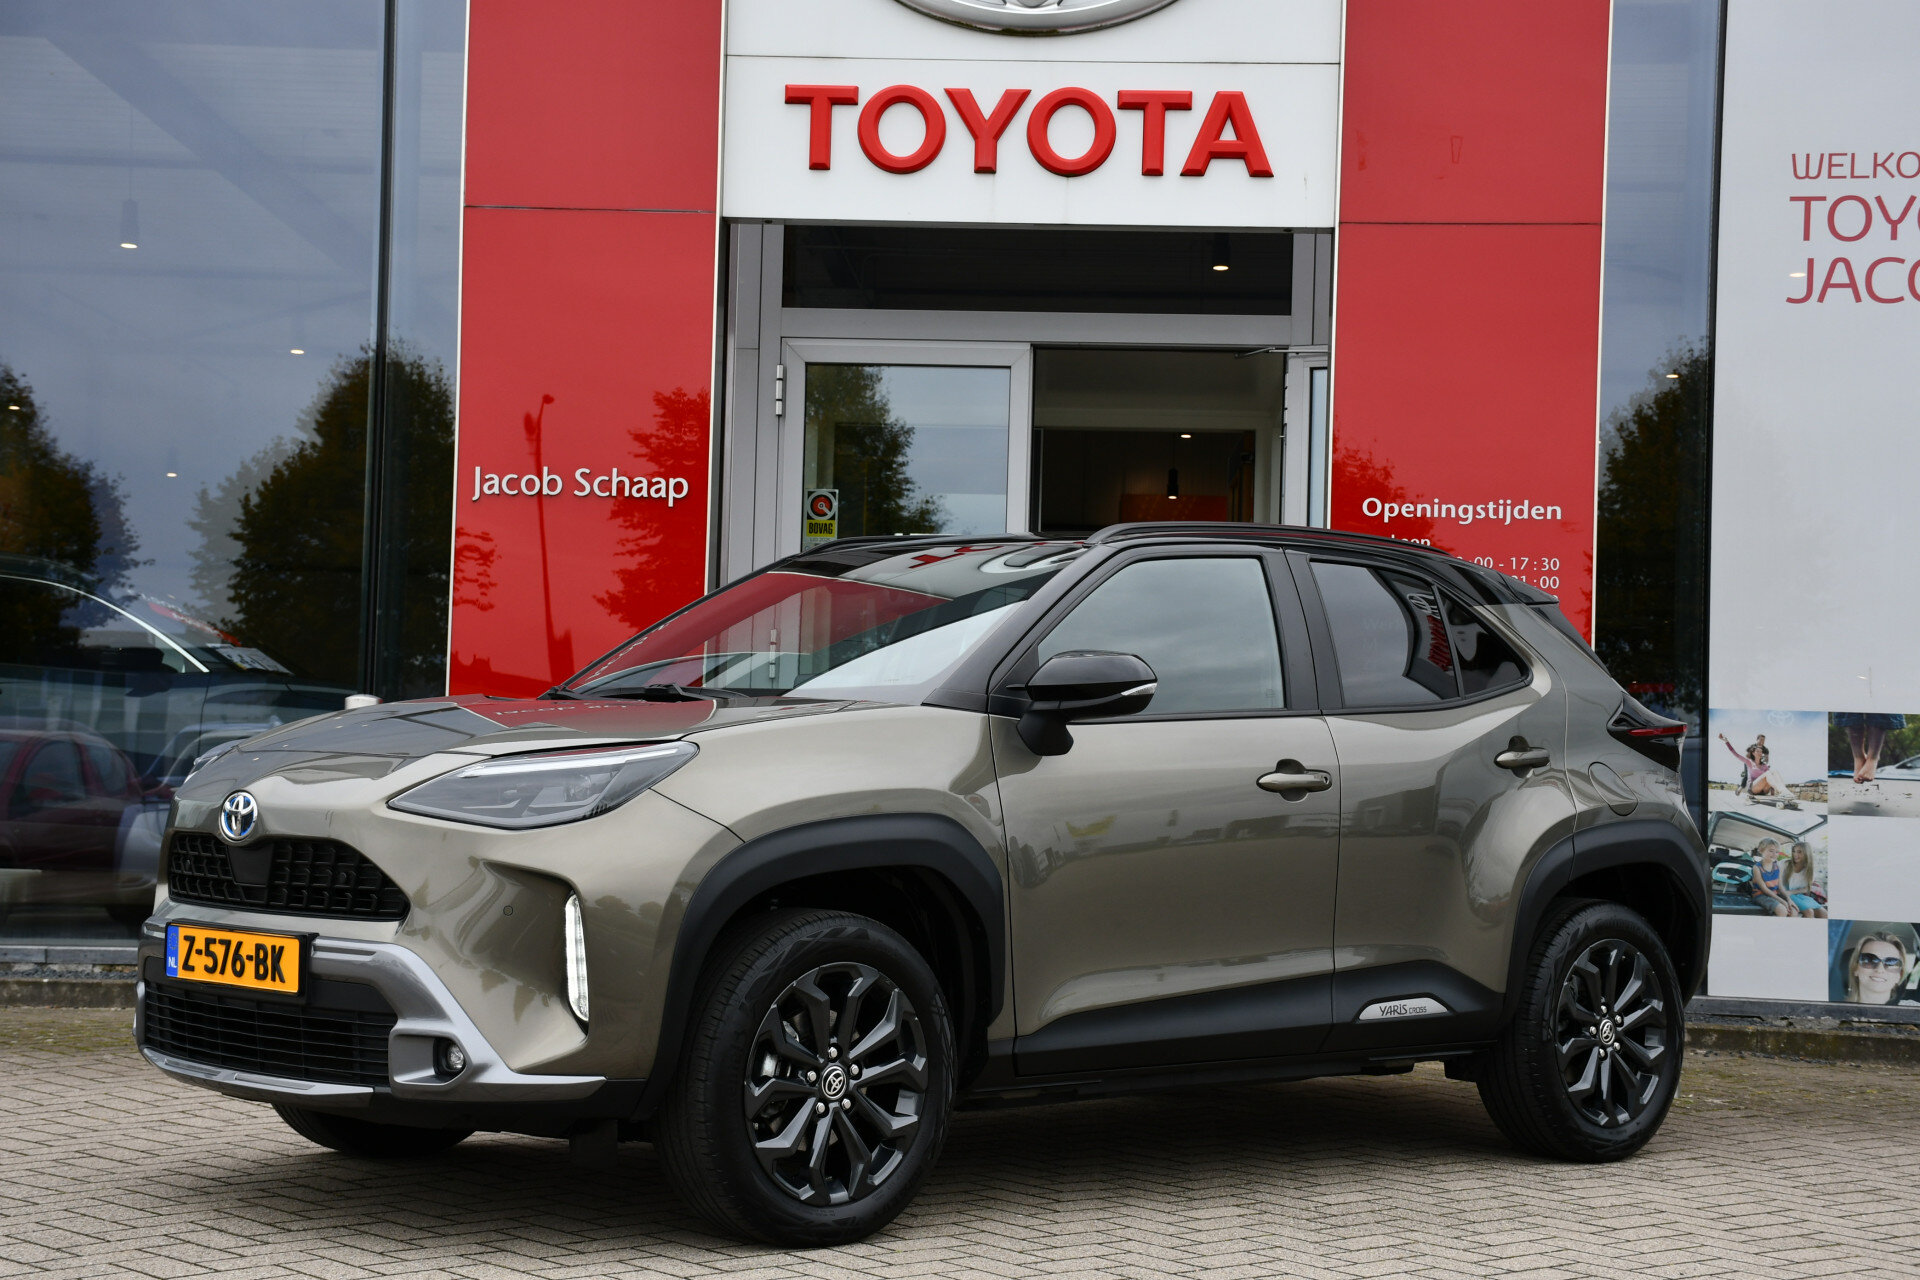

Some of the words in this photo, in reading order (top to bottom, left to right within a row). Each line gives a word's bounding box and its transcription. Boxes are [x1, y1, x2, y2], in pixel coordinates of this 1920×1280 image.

[784, 83, 1274, 178] TOYOTA
[1791, 151, 1920, 180] WELKO
[1789, 194, 1920, 242] TOY
[1785, 256, 1920, 304] JAC
[472, 466, 563, 501] Jacob
[573, 467, 689, 507] Schaap
[808, 522, 833, 535] BOVAG
[1362, 497, 1562, 525] Openingstijden
[168, 956, 177, 969] NL
[182, 935, 285, 983] Z-576-BK
